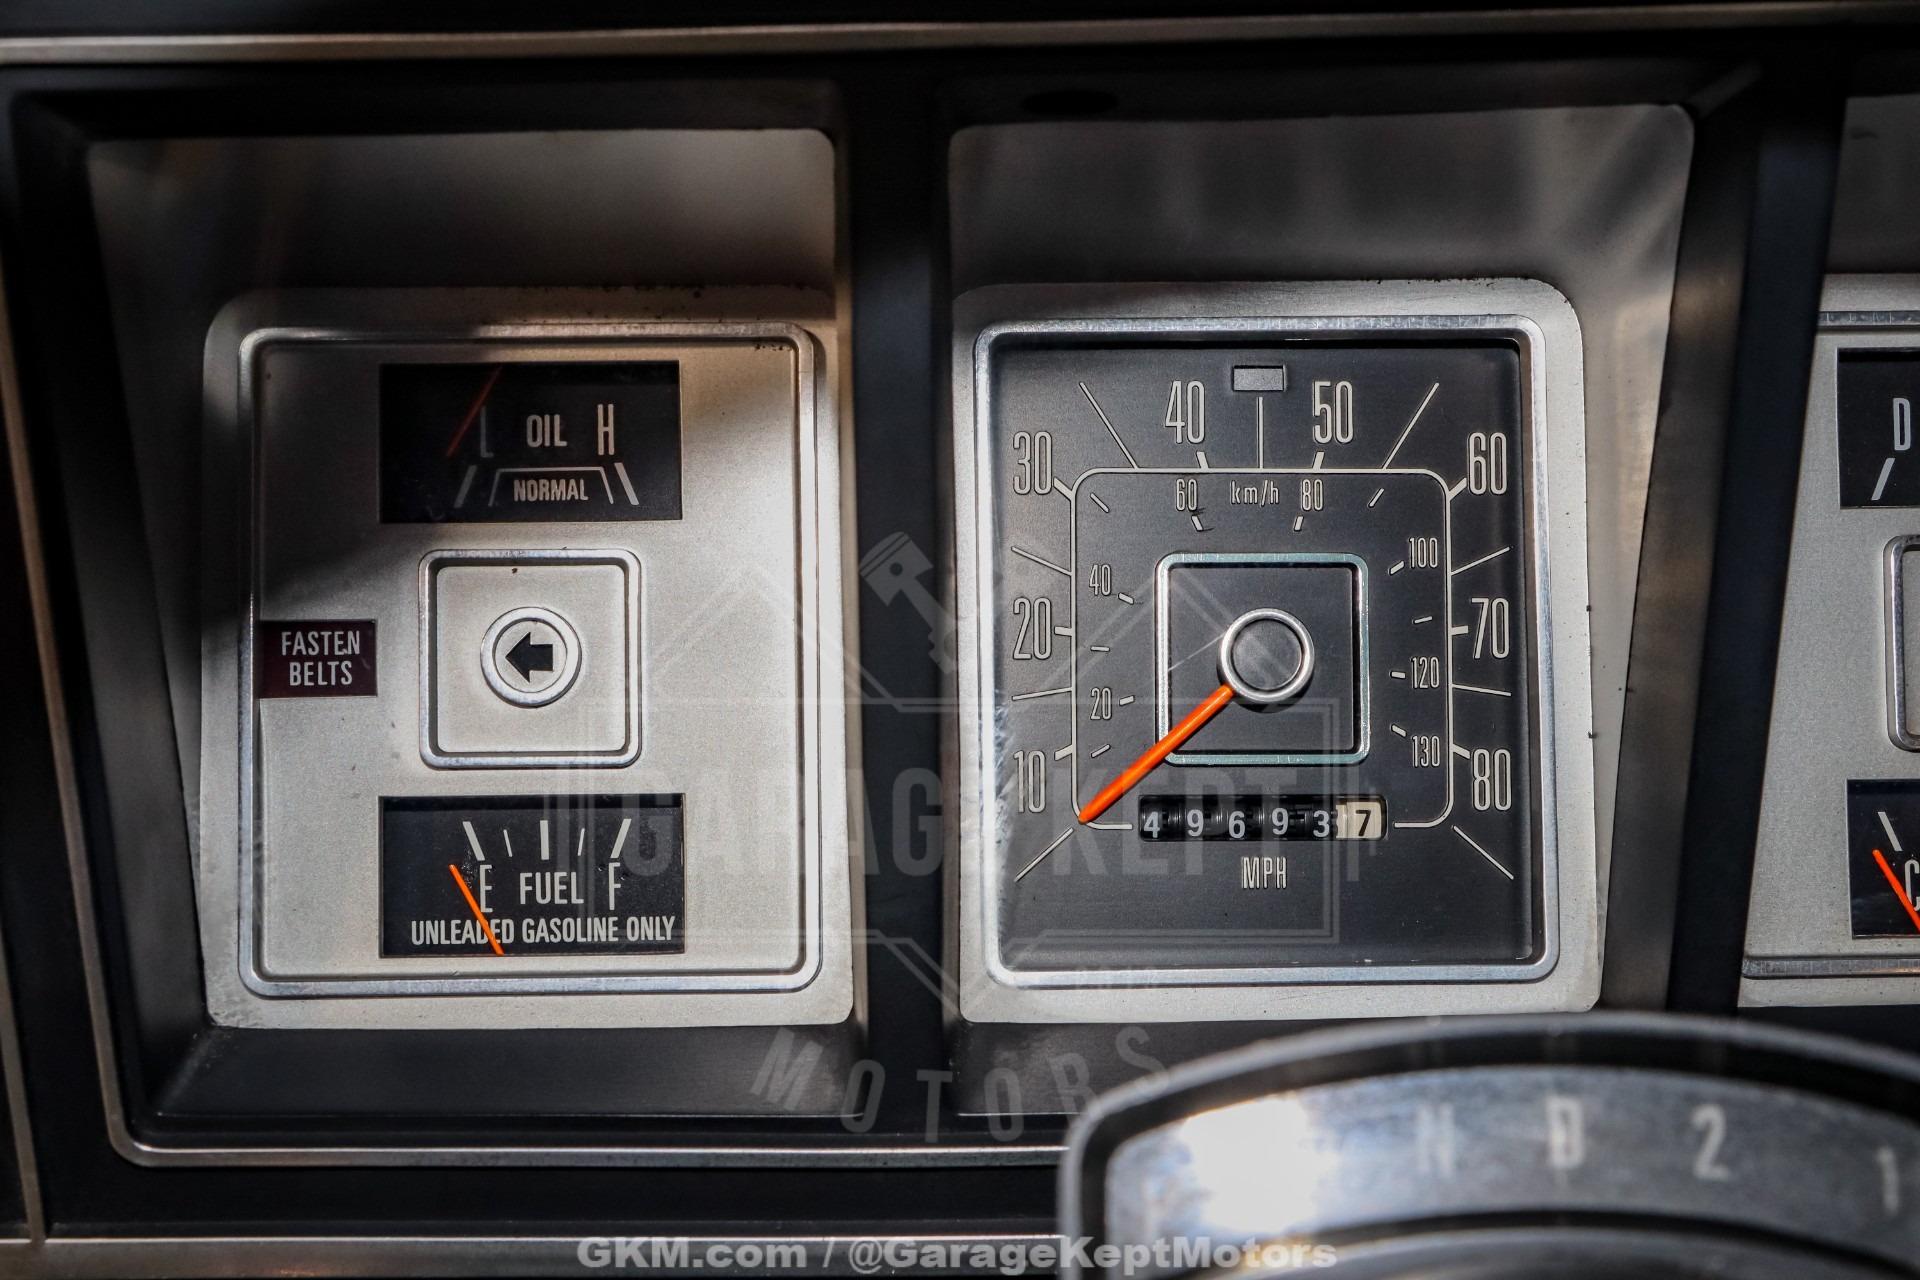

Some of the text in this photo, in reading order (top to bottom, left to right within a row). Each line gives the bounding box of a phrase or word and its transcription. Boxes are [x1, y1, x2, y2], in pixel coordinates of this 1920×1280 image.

[1165, 380, 1205, 444] 40
[1313, 380, 1353, 444] 50
[526, 414, 568, 448] OIL
[597, 403, 615, 456] H
[1012, 431, 1053, 496] 30
[1468, 432, 1508, 496] 60
[513, 478, 589, 502] NORMAL
[1175, 478, 1198, 512] 60
[1230, 479, 1280, 507] km/h
[1301, 478, 1324, 512] 80
[1408, 537, 1438, 569] 100
[1088, 564, 1112, 596] 40
[281, 630, 361, 656] FASTEN
[1012, 597, 1051, 660] 20
[1471, 597, 1510, 660] 70
[289, 660, 353, 686] BELTS
[1410, 656, 1441, 689] 120
[1089, 687, 1112, 720] 20
[1411, 735, 1441, 768] 130
[1013, 750, 1046, 813] 10
[1472, 748, 1512, 811] 80
[479, 864, 494, 913] E
[519, 871, 584, 905] FUEL
[608, 862, 622, 911] F
[1241, 856, 1288, 889] MPH
[522, 916, 620, 943] GASOLINE
[626, 915, 676, 942] ONLY
[1691, 1103, 1732, 1183] 2
